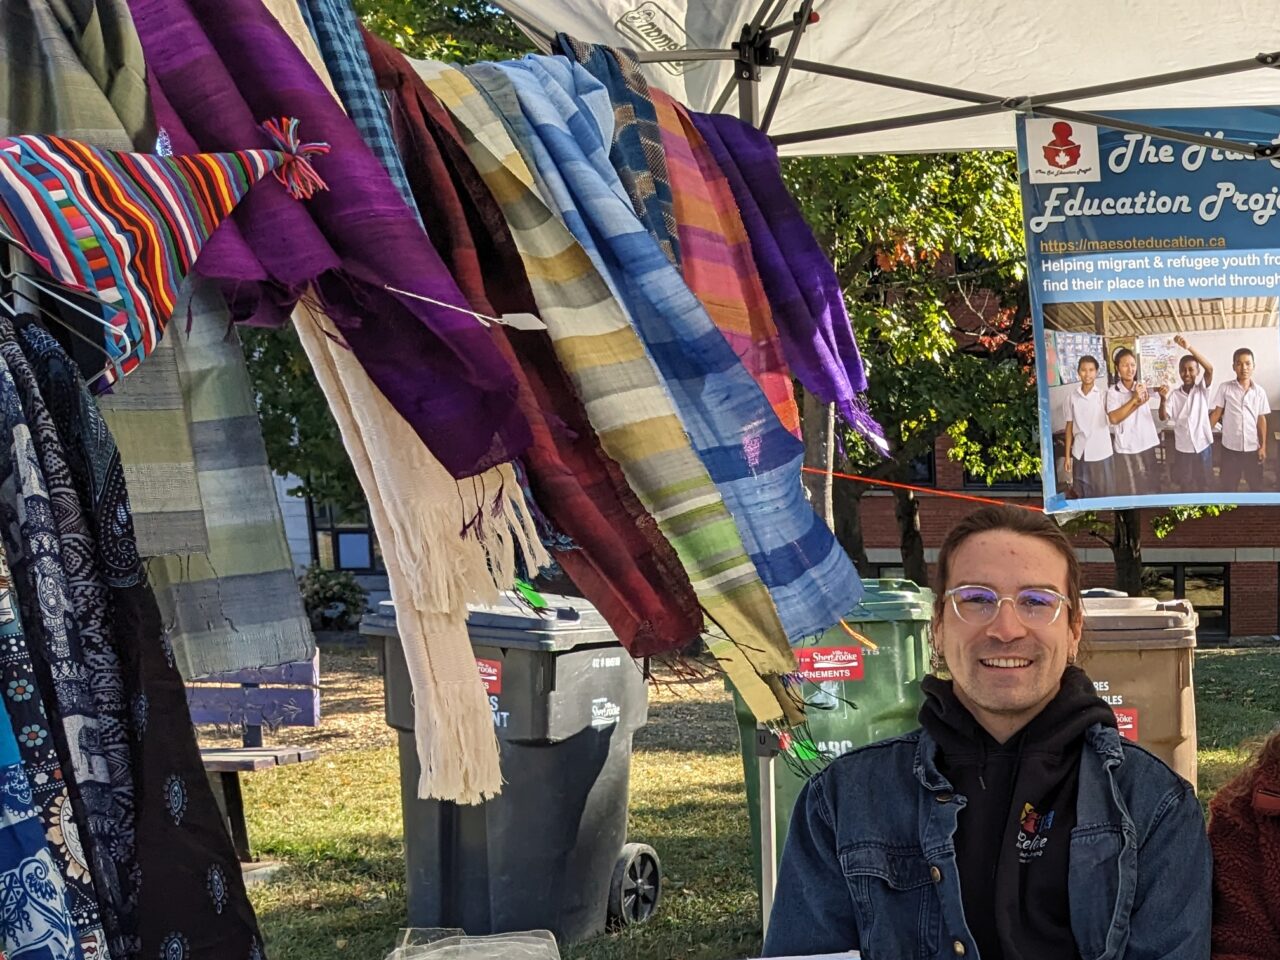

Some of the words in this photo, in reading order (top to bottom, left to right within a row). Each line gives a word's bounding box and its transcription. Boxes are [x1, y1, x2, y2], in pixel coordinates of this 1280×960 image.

[1108, 134, 1175, 174] The
[1029, 186, 1193, 234] Education
[1040, 235, 1226, 253] https://maesoteducation.ca
[1041, 259, 1094, 273] Helping
[1097, 257, 1150, 272] migrant
[1153, 256, 1164, 268] &
[1167, 254, 1219, 270] refugee
[1222, 253, 1260, 269] youth
[1042, 280, 1069, 292] find
[1072, 278, 1104, 290] their
[1107, 277, 1145, 293] place
[1148, 276, 1159, 289] in
[1163, 275, 1185, 288] the
[1188, 274, 1226, 288] world
[795, 669, 850, 679] VÉNEMENTS
